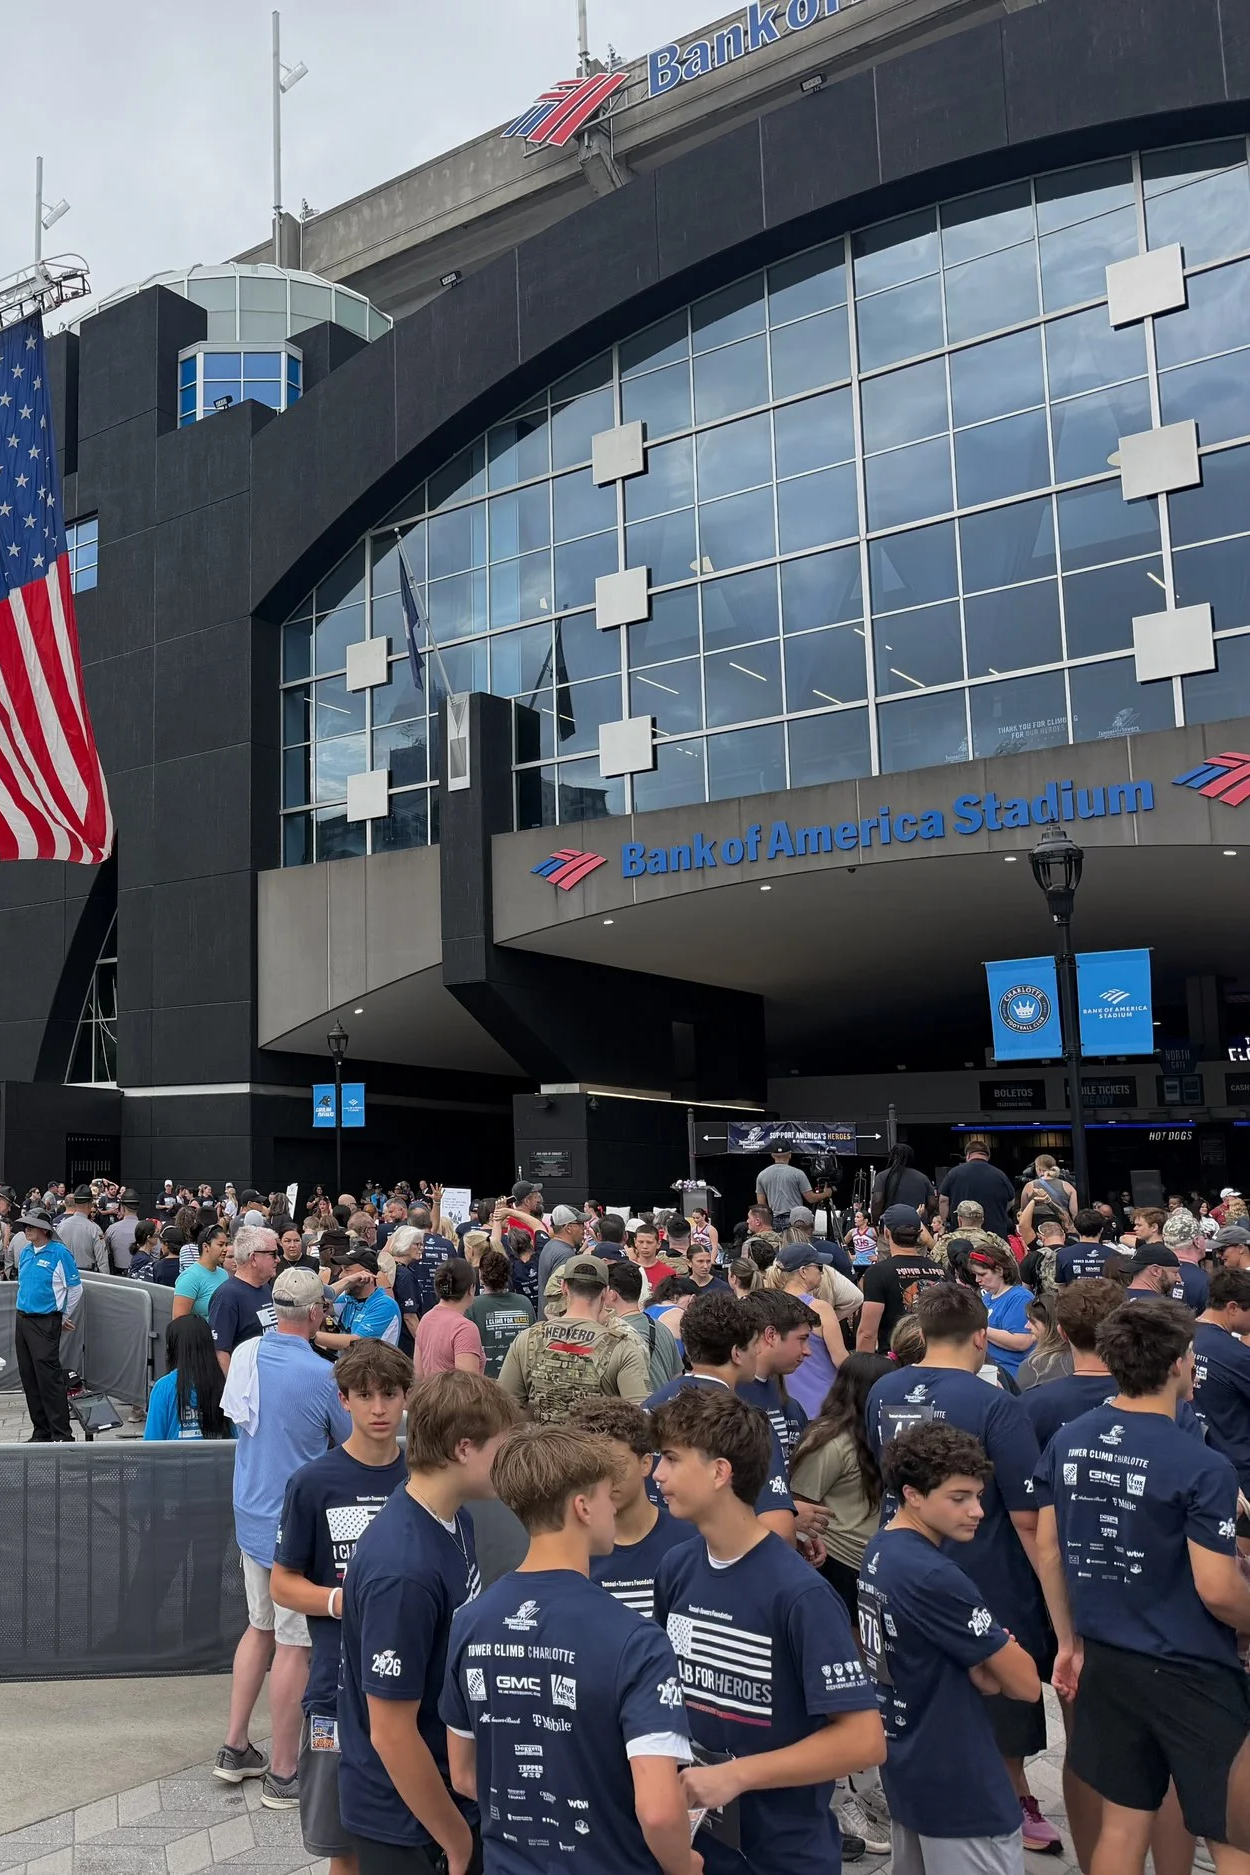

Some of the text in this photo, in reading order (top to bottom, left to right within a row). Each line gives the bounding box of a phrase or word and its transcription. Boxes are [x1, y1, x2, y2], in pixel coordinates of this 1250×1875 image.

[647, 0, 781, 98] Bank
[998, 714, 1078, 735] THANK YOU FOR CLIMBG
[1011, 731, 1024, 739] FOR
[622, 780, 1154, 878] Bank of America Stadium
[1003, 987, 1043, 1002] CHARLOTTE
[1006, 1016, 1045, 1031] FOOTBALL CLUB
[1165, 1048, 1190, 1061] NORTH
[994, 1088, 1033, 1098] BOLETOS
[1098, 1084, 1130, 1095] TICKETS
[769, 1131, 851, 1140] SUPPORT AMERICA'S HEROES
[1149, 1131, 1193, 1141] HOT DOGS
[1068, 1448, 1149, 1469] TOWER CLIMB CHARLOTTE
[1126, 1550, 1144, 1558] wtw
[468, 1643, 575, 1664] TOWER CLIMB CHARLOTTE
[496, 1675, 541, 1690] GMC
[561, 1683, 574, 1695] FOX
[695, 1666, 714, 1692] FOR
[714, 1674, 773, 1704] HEROES
[556, 1691, 575, 1704] NEWS
[567, 1799, 589, 1809] wtw
